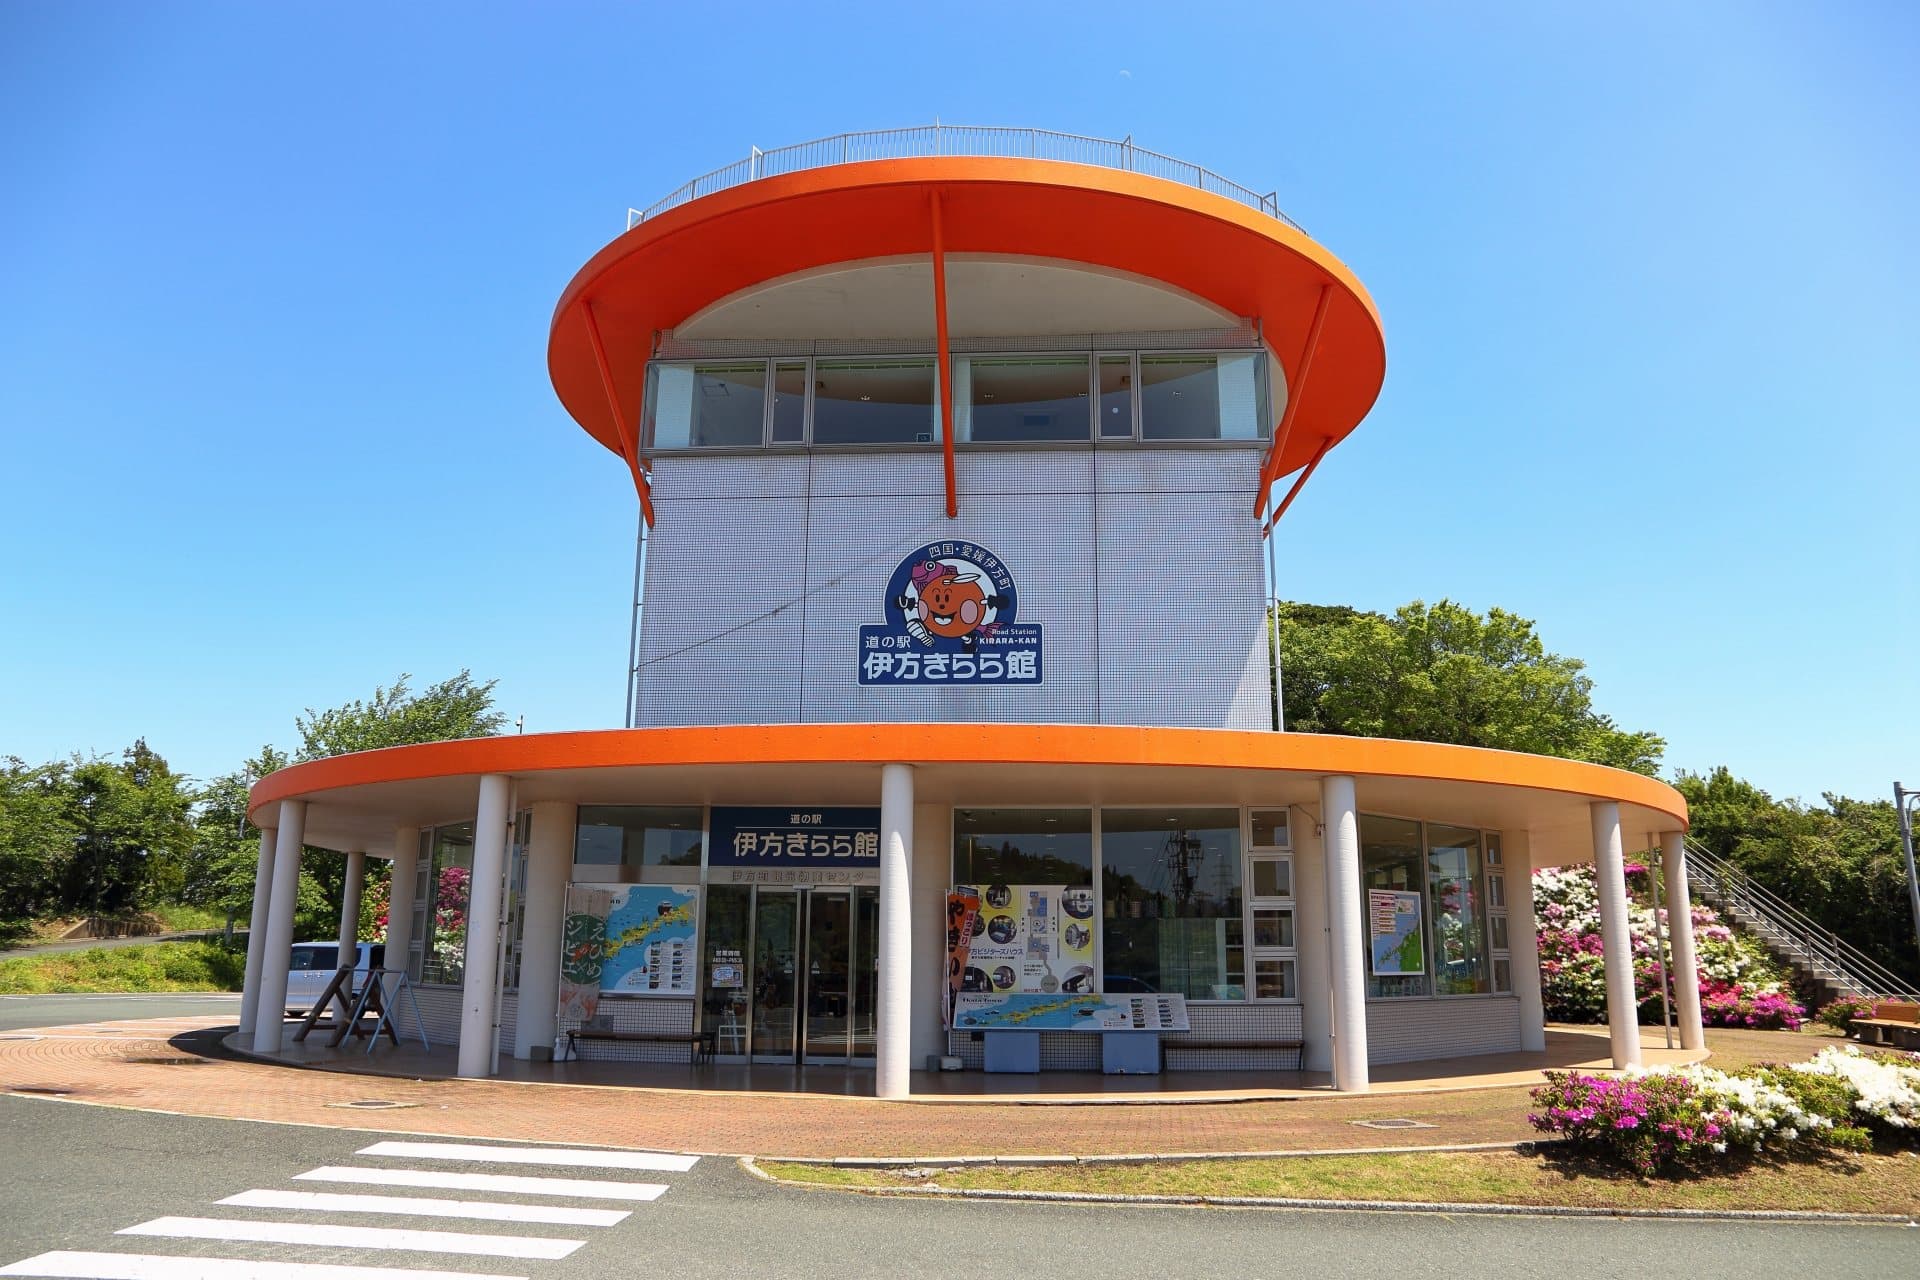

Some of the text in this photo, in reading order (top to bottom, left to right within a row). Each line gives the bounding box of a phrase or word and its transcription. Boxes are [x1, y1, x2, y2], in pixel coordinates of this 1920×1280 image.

[928, 543, 1011, 590] 四国・愛媛伊方町
[979, 637, 1037, 645] KIRARA-KAN
[991, 628, 1037, 636] Road Station
[865, 636, 911, 649] 道の駅
[863, 650, 1037, 679] 伊方きらら館
[790, 814, 822, 825] 道の駅
[733, 831, 879, 857] 伊方きらら館
[586, 922, 605, 978] えひめ
